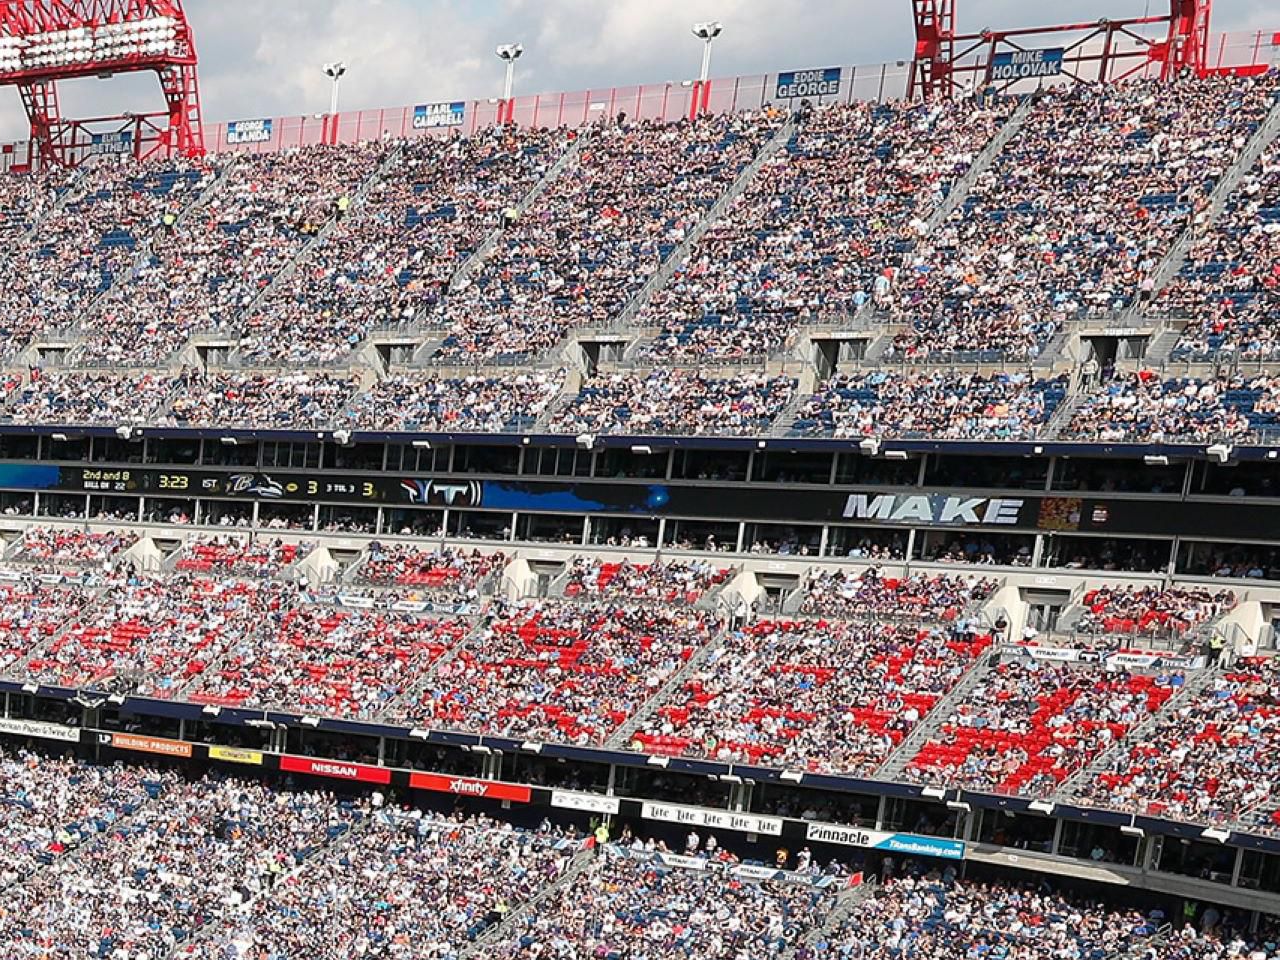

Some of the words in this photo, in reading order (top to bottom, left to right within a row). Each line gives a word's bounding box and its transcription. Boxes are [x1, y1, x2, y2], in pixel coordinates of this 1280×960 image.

[1010, 51, 1043, 64] MIKE
[793, 72, 825, 83] EDDIE
[993, 63, 1060, 79] HOLOVAK
[778, 82, 838, 96] GEORGE
[425, 104, 453, 114] EARL
[236, 120, 265, 131] GEORGE
[413, 113, 464, 128] CAMPBELL
[228, 130, 270, 143] BLANDA
[83, 470, 101, 479] 2nd
[102, 471, 120, 480] and
[159, 475, 189, 488] 3:23
[114, 482, 126, 490] 22
[307, 481, 318, 494] 3
[362, 483, 373, 496] 3
[842, 494, 1024, 524] MAKE
[22, 723, 40, 734] Paper
[48, 726, 66, 737] Twine
[99, 734, 111, 743] LP
[115, 737, 149, 750] BUILDING
[150, 741, 191, 755] PRODUCTS
[311, 762, 357, 777] NISSAN
[449, 779, 489, 794] xfinity
[650, 806, 669, 818] Lite
[677, 809, 696, 822] Lite
[703, 813, 723, 825] Lite
[730, 816, 750, 828] Lite
[758, 820, 778, 832] Lite
[809, 825, 870, 845] Pinnacle
[890, 840, 961, 857] TitansBanking.com
